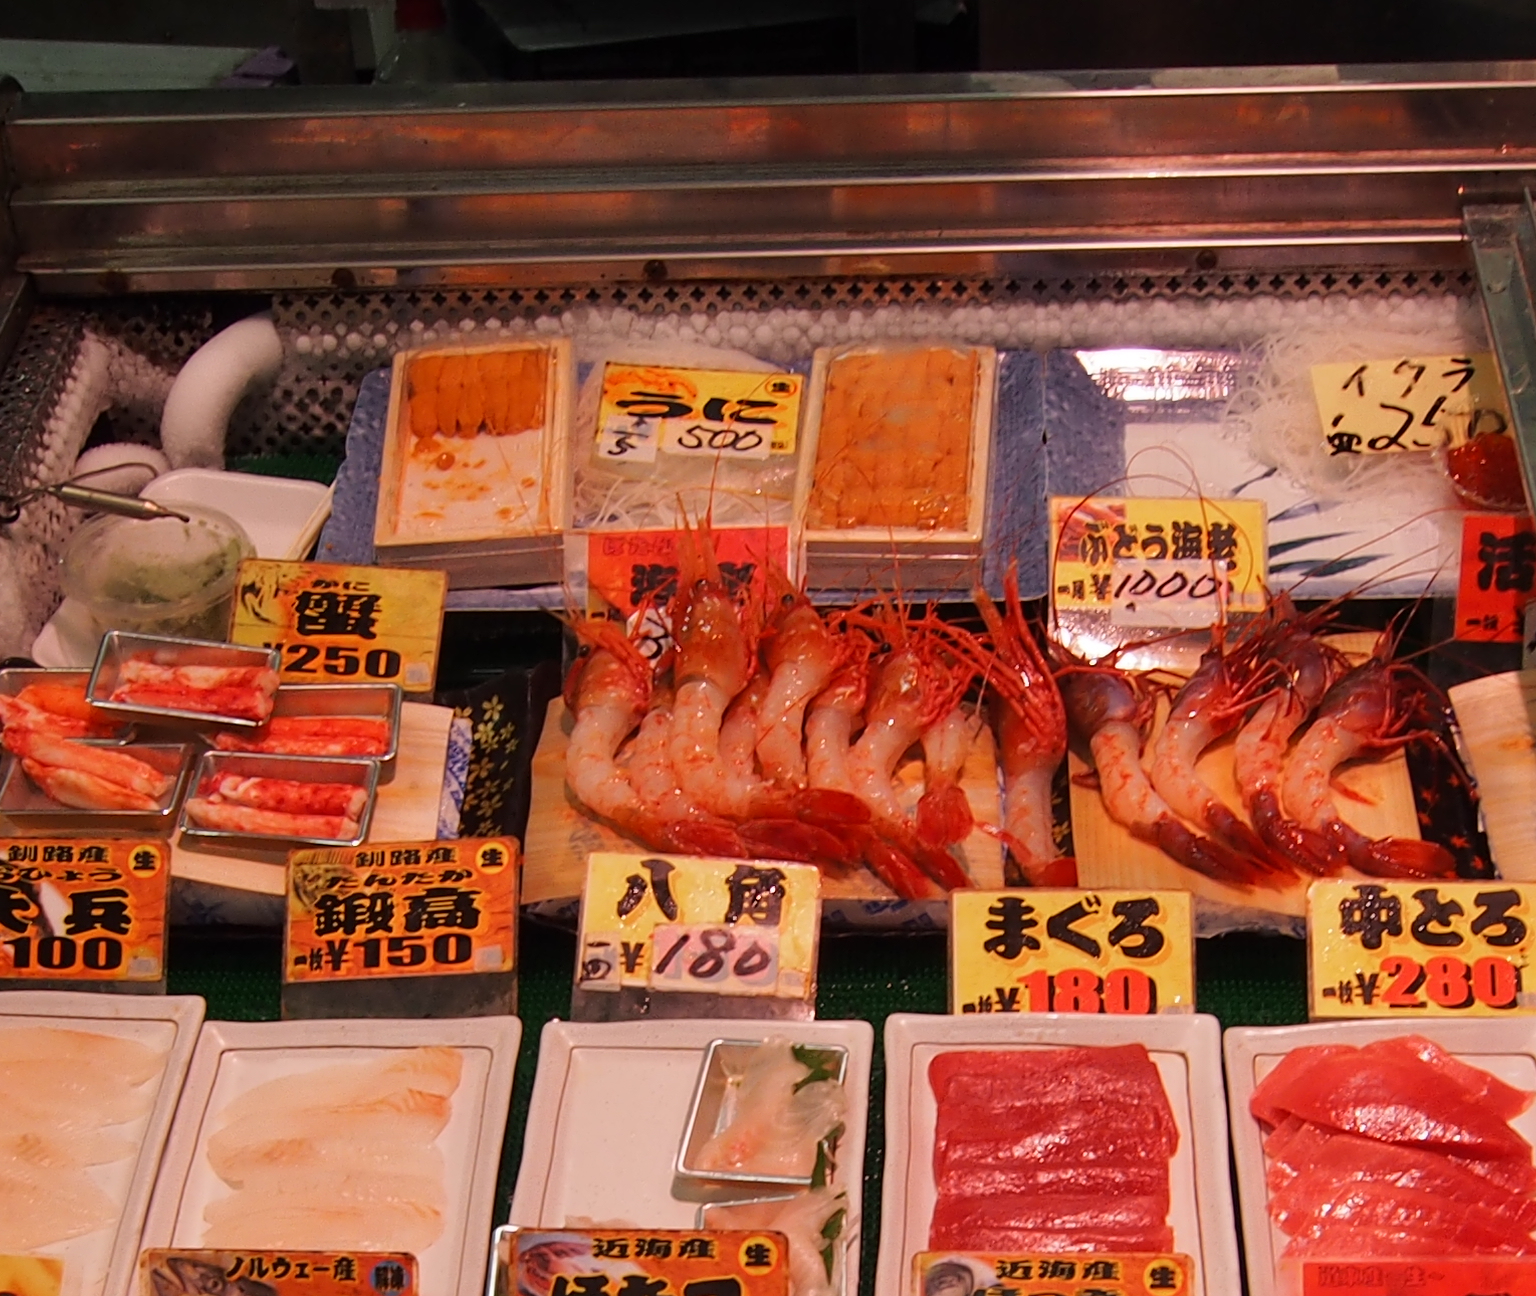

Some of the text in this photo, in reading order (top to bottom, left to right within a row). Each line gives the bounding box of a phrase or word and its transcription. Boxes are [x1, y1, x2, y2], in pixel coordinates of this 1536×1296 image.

[615, 391, 778, 425] うに
[134, 852, 155, 870] 生
[481, 848, 502, 867] 生
[617, 860, 786, 926] 八角
[984, 895, 1164, 959] まぐろ
[1340, 885, 1526, 949] 中とろ
[593, 1238, 716, 1259] 近海産
[745, 1244, 771, 1266] 生
[226, 1257, 357, 1282] ノルウェー産
[997, 1260, 1121, 1281] 近海産
[1150, 1267, 1176, 1288] 生
